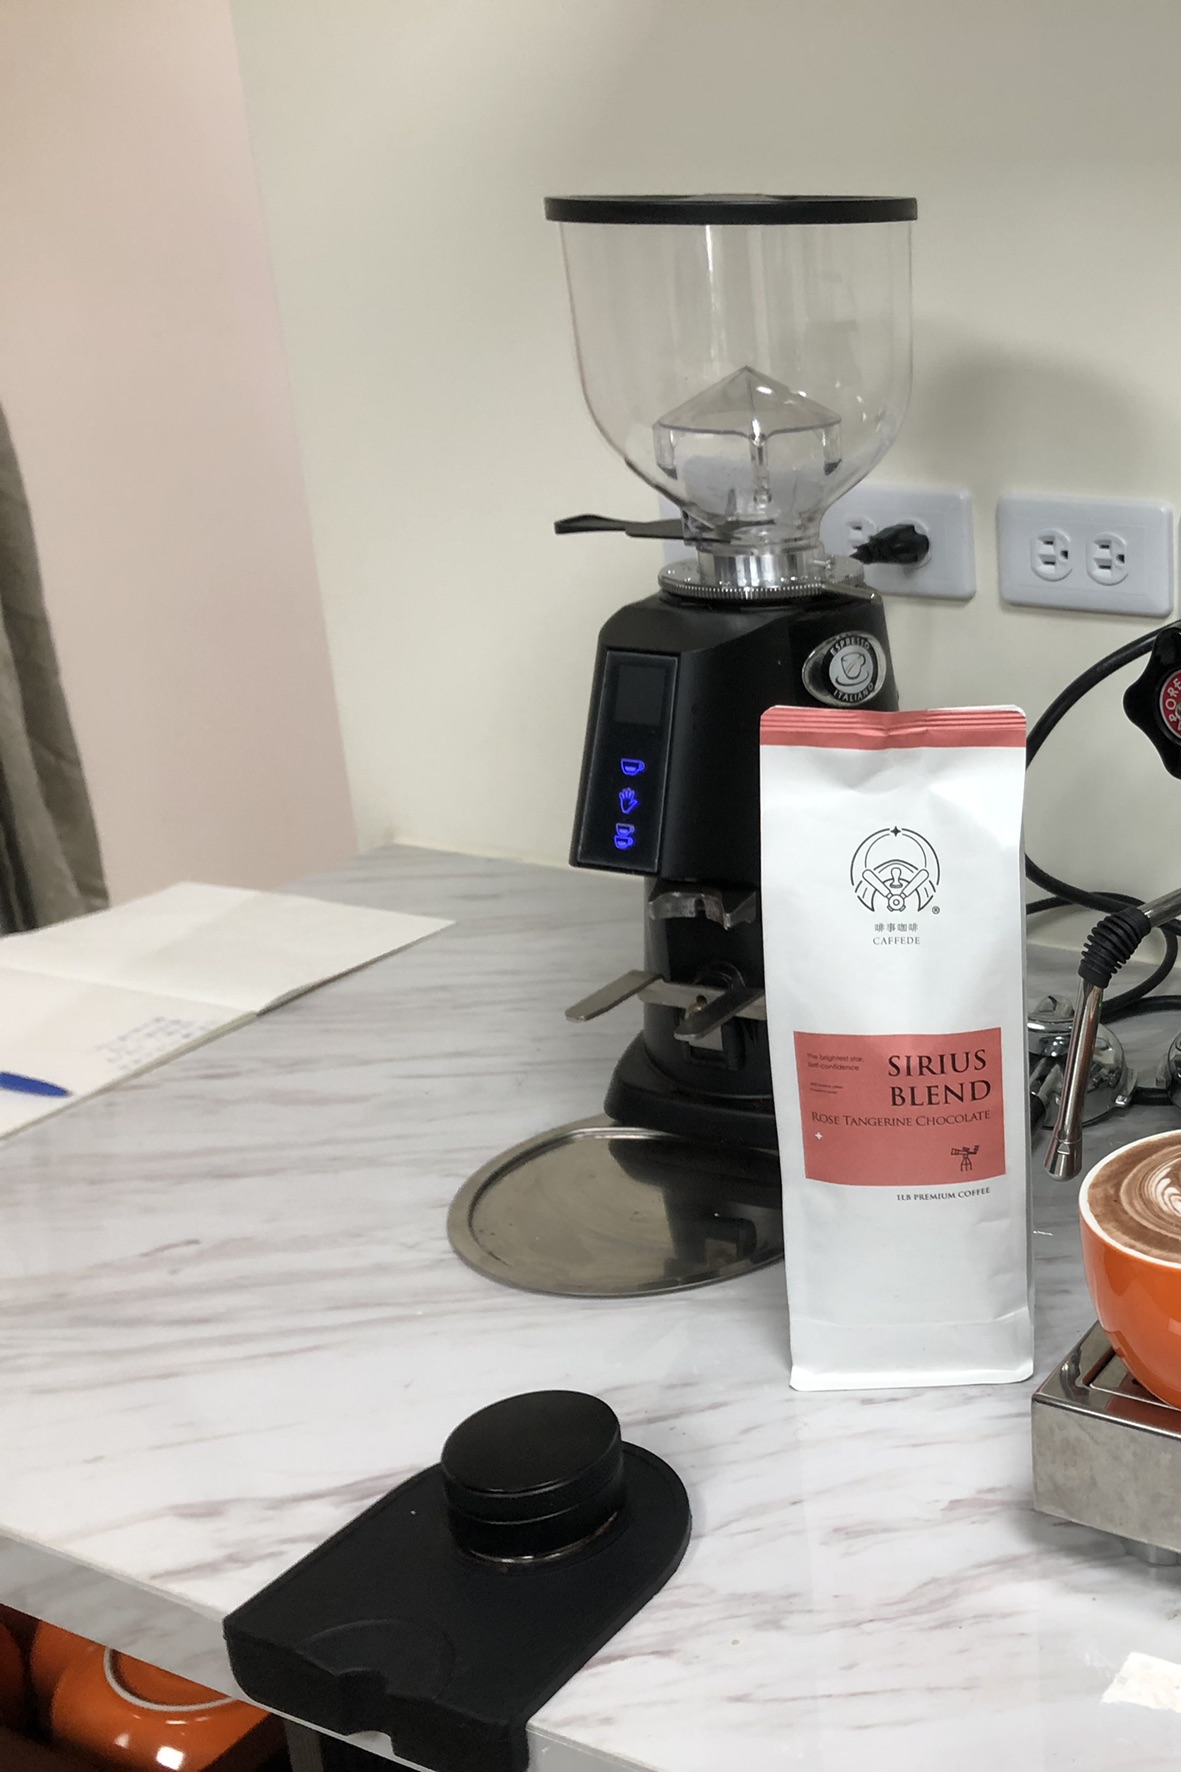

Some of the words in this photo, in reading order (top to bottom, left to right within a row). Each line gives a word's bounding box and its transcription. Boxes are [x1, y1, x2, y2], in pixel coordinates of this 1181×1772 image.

[830, 637, 870, 656] ESPRESSO
[833, 683, 874, 702] ITALIANO
[872, 936, 921, 945] CAFFEDE
[888, 1049, 987, 1077] SIRIUS
[890, 1079, 992, 1107] BLEND
[914, 1192, 956, 1201] PREMIUM
[957, 1187, 991, 1198] COFFEE
